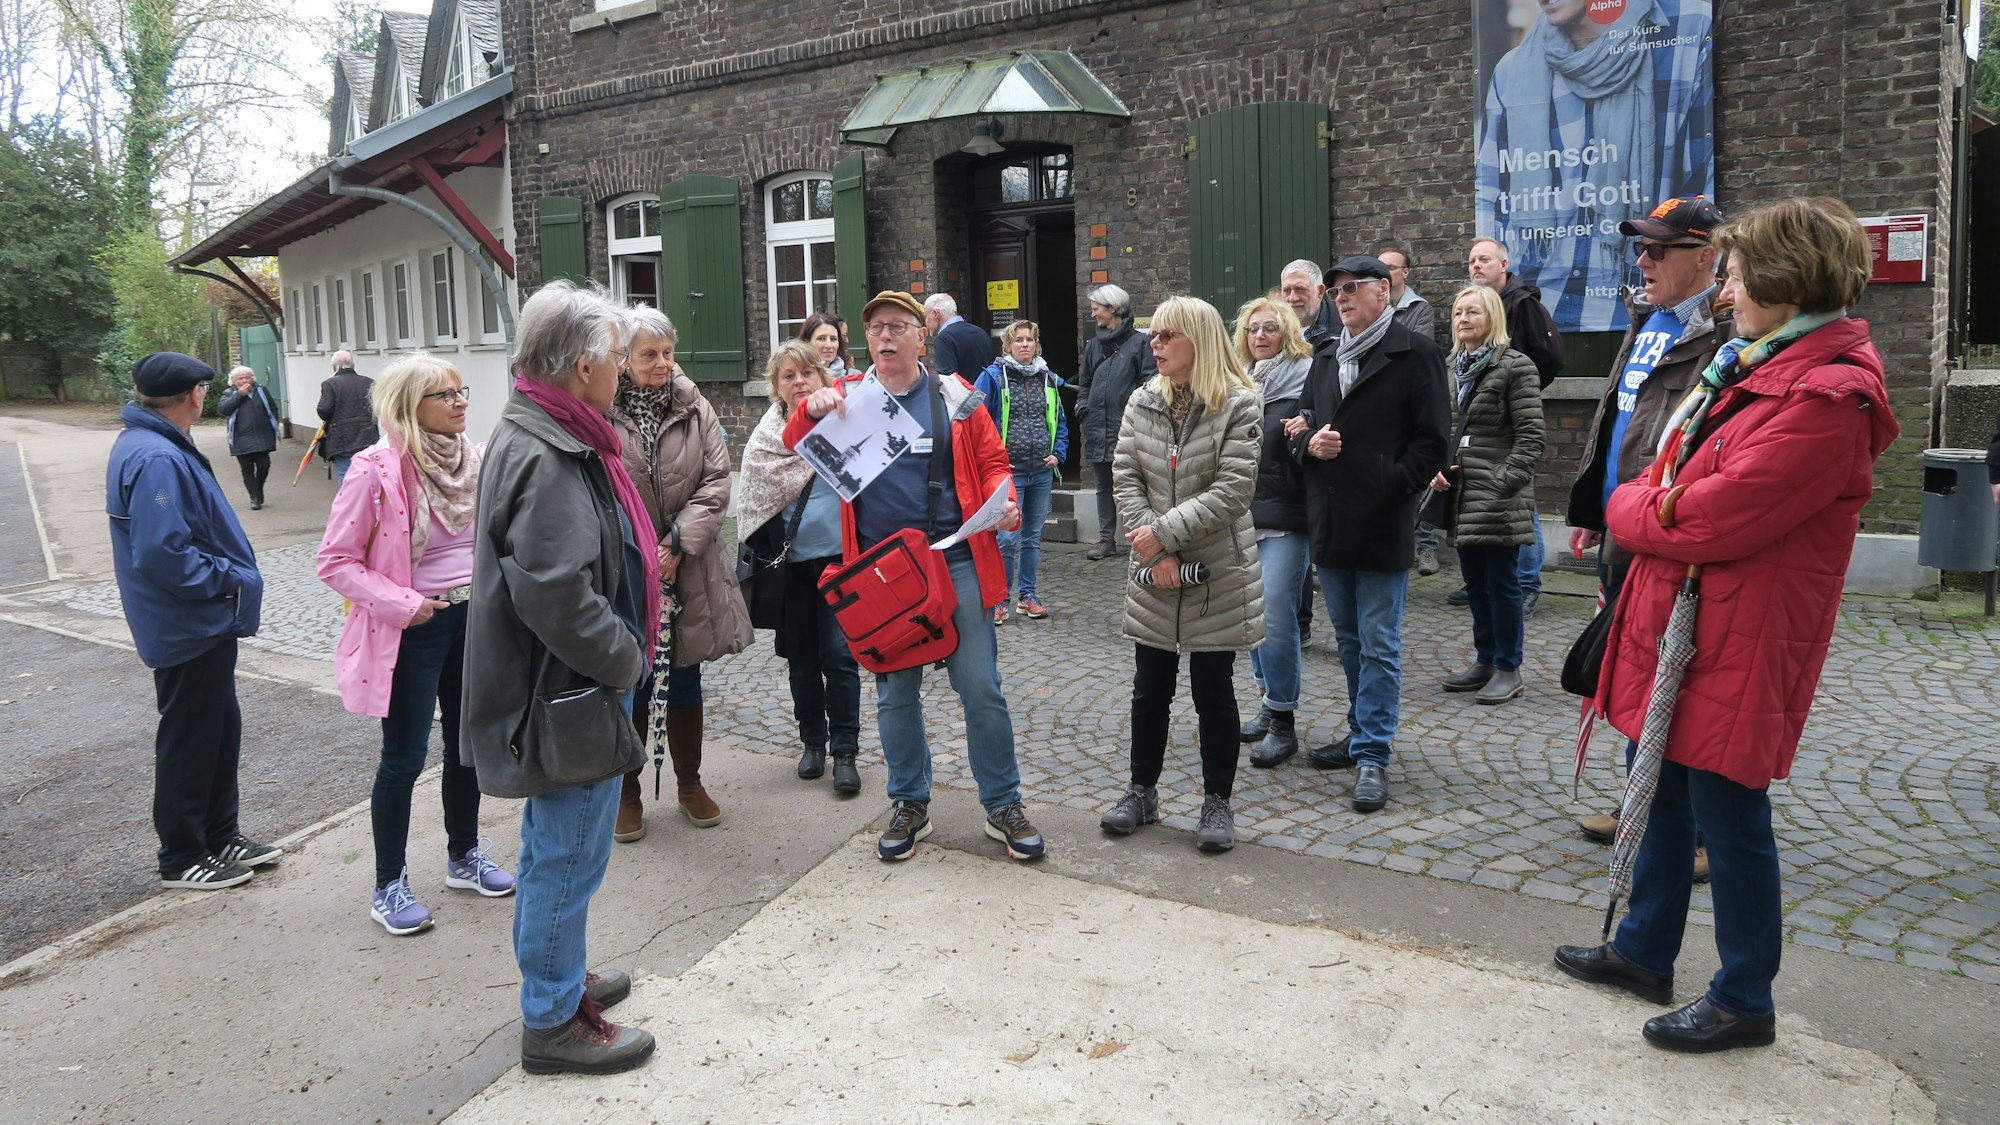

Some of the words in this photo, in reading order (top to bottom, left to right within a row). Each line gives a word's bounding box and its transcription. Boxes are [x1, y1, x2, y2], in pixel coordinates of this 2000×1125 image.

[1590, 0, 1622, 12] Alpha
[1608, 29, 1629, 40] Der
[1632, 25, 1661, 36] Kurs
[1609, 44, 1626, 55] für
[1628, 35, 1698, 52] Sinnsucher
[1499, 138, 1618, 174] Mensch
[1127, 187, 1138, 207] 8
[1499, 185, 1563, 214] trifft
[1573, 180, 1650, 208] Gott.
[1500, 227, 1516, 242] In
[1521, 223, 1594, 241] unserer
